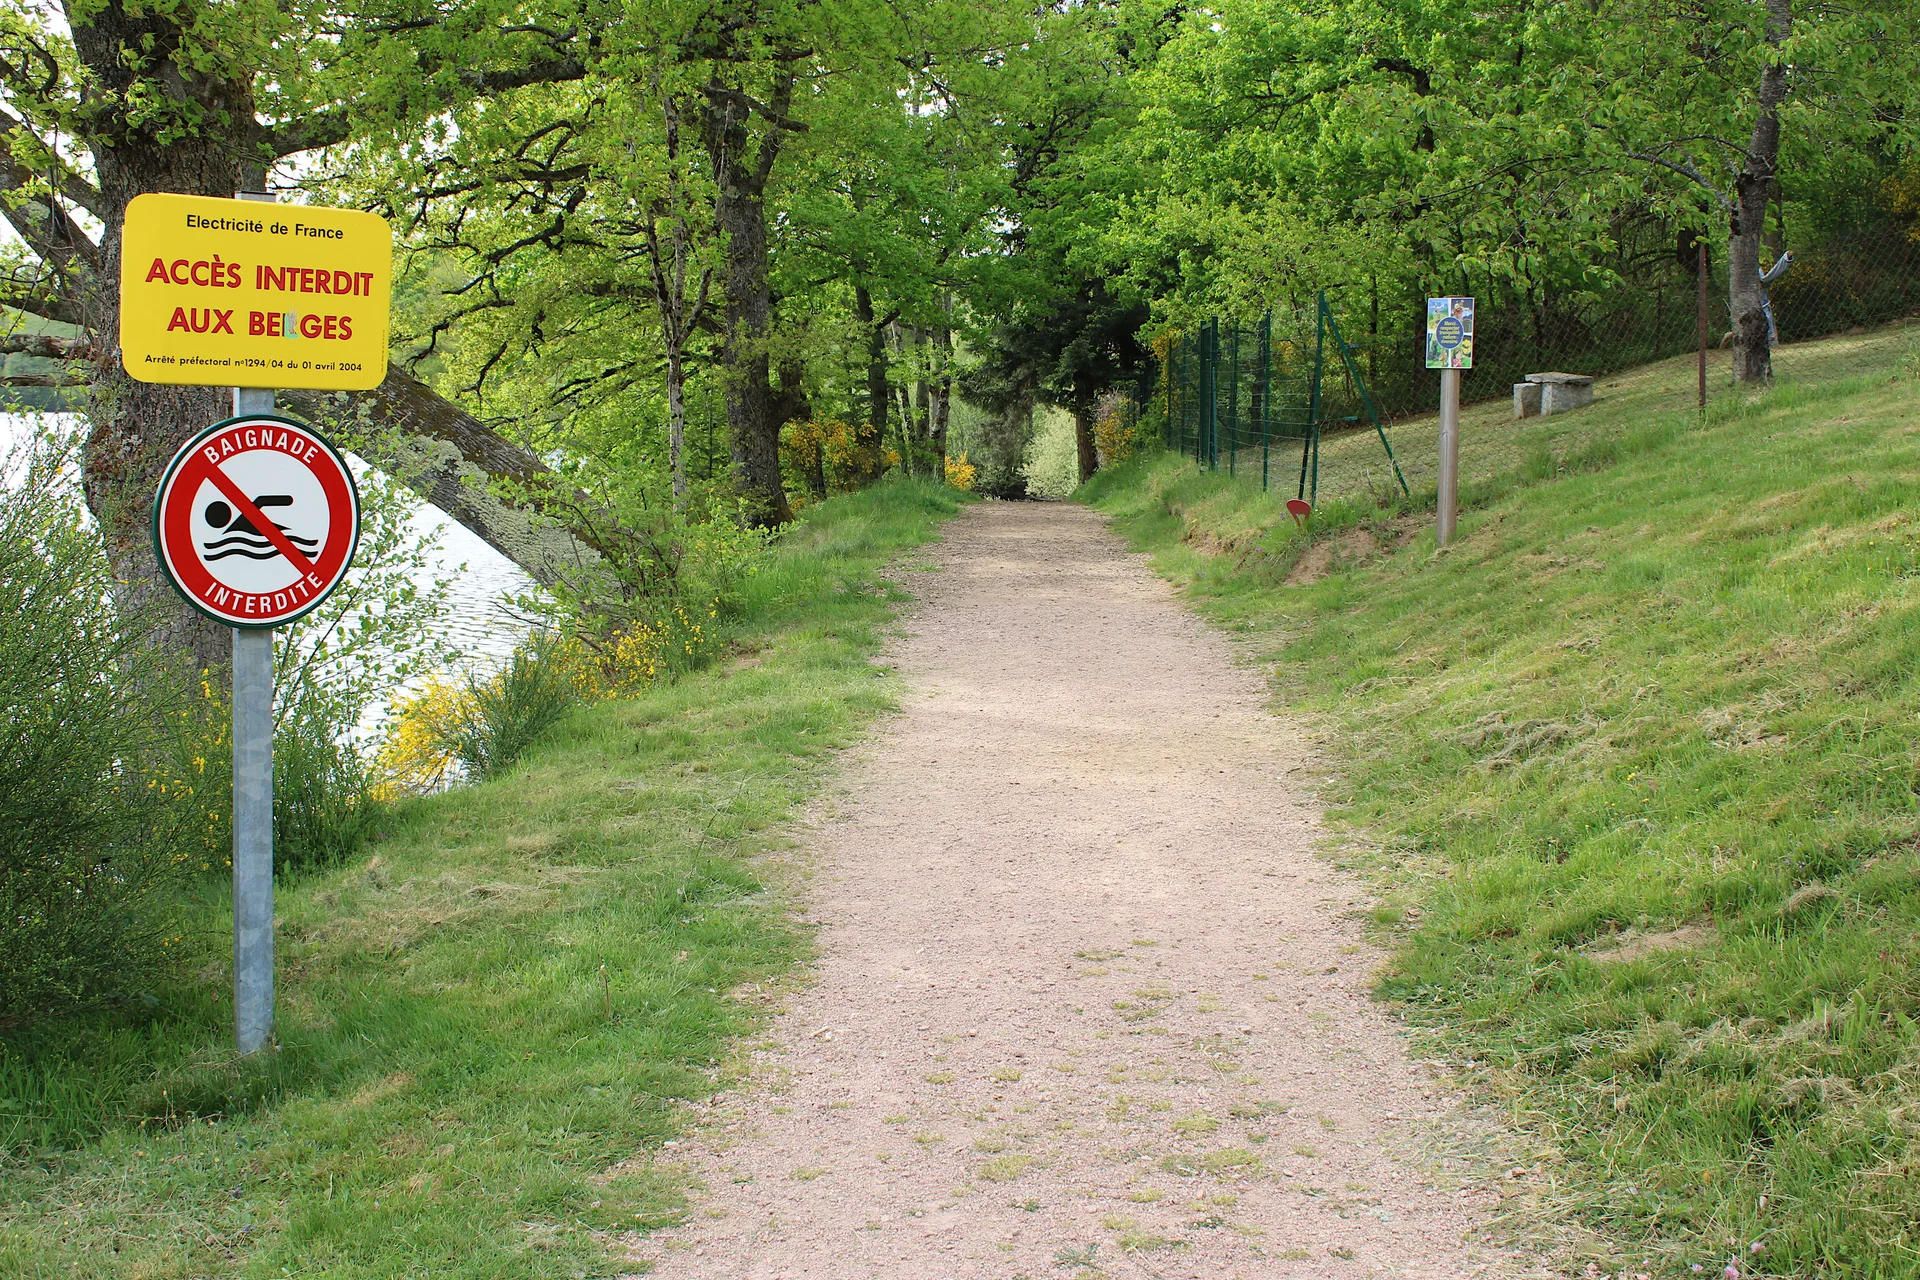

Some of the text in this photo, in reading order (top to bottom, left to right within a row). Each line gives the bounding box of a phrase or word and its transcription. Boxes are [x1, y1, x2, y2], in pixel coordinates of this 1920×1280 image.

[187, 214, 343, 239] Electricité de France
[145, 254, 373, 296] ACCÈS INTERDIT
[167, 307, 234, 334] AUX
[145, 354, 176, 364] Arrêté
[180, 355, 231, 367] préfectoral
[287, 360, 298, 369] du
[301, 360, 311, 370] 01
[315, 361, 335, 371] avril
[339, 362, 362, 372] 2004
[203, 429, 319, 465] BAIGNADE
[204, 571, 324, 614] INTERDITE
